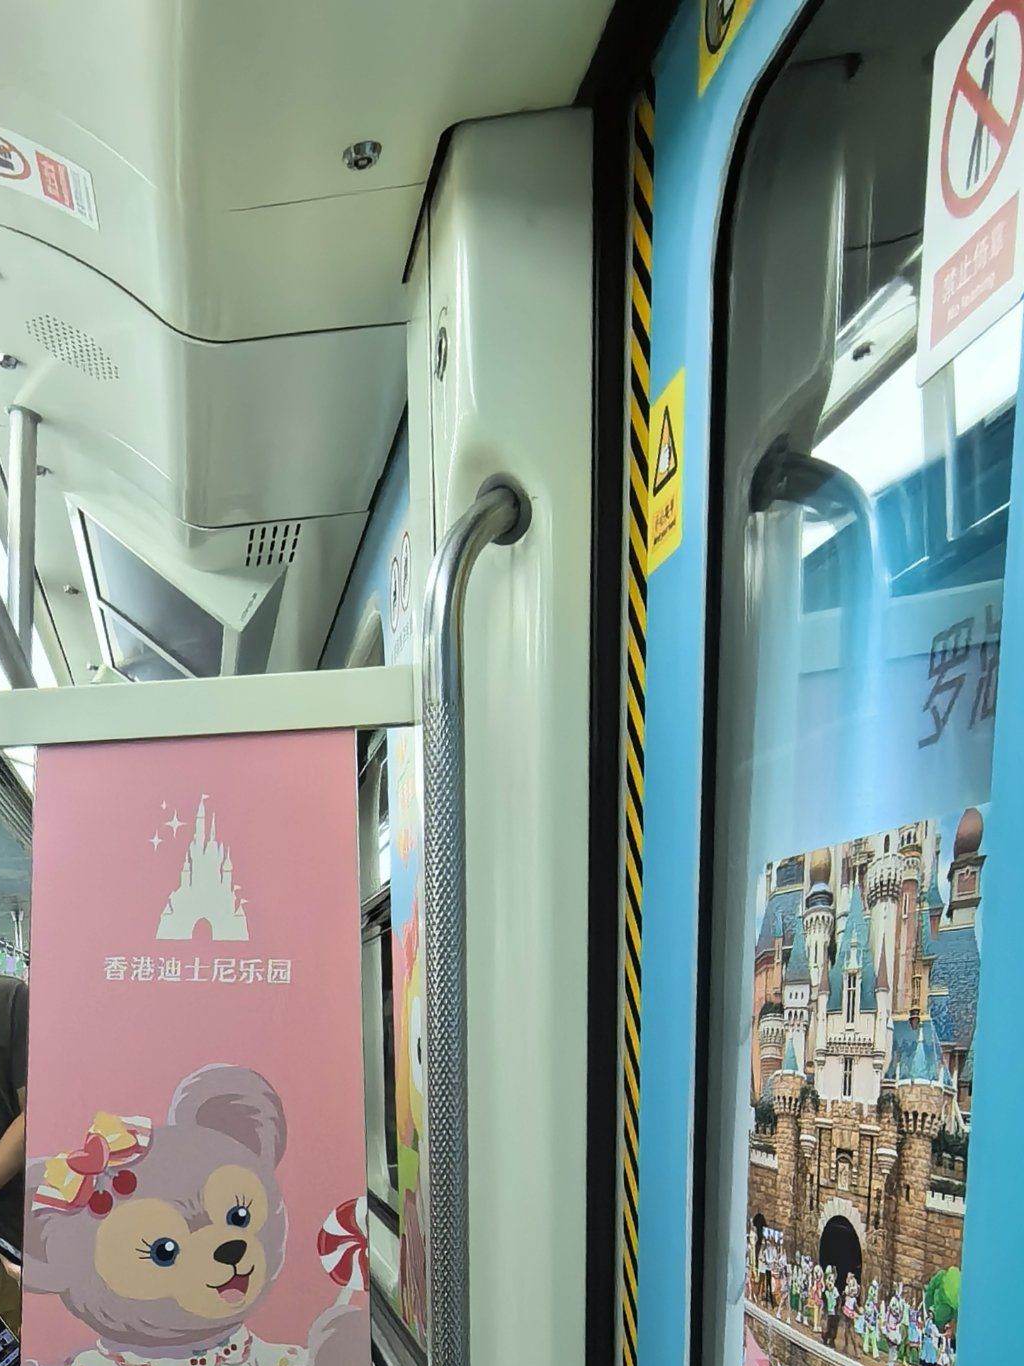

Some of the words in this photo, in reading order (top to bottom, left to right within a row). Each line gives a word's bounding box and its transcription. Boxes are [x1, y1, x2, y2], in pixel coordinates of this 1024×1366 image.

[104, 956, 292, 985] 香港迪士尼乐园
